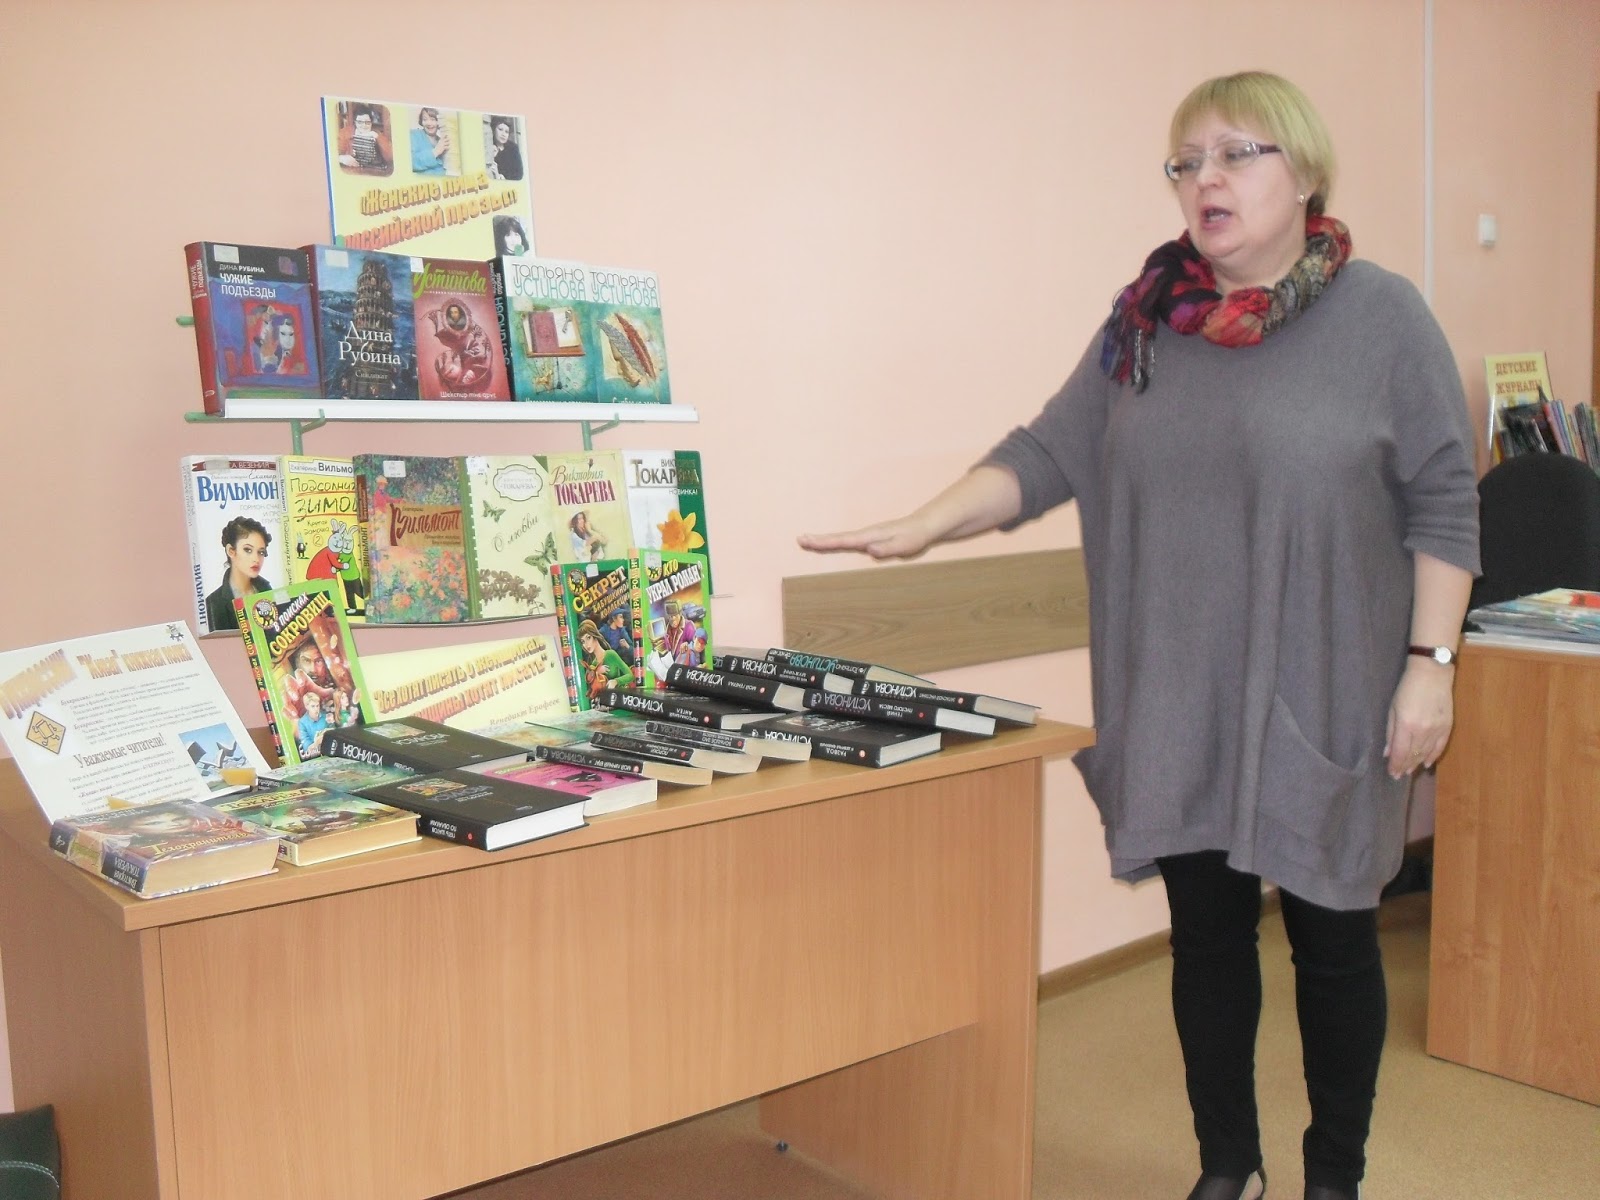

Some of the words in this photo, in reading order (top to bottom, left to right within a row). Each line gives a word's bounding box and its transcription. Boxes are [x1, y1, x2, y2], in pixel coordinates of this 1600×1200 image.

[219, 263, 238, 271] ДИНА
[239, 265, 265, 273] РУБИНА
[219, 272, 254, 285] ЧУЖИЕ
[413, 263, 487, 298] Устинова
[514, 276, 586, 299] УСТИНОВА
[221, 284, 276, 299] ПОДЪЕЗДЫ
[592, 283, 660, 308] УСТИНОВА
[344, 320, 393, 343] Дина
[338, 341, 401, 366] Рубина
[238, 461, 270, 469] ВЕЗЕНИЯ
[318, 462, 353, 473] Вильмо
[550, 465, 604, 485] Виктория
[197, 476, 279, 509] Вильмон
[554, 480, 616, 506] ТОКАРЕВА
[360, 527, 370, 568] ВИЛЬМОНТ
[663, 559, 679, 578] КТО
[573, 566, 627, 612] СЕКРЕТ
[646, 578, 673, 604] УКРАЛ
[671, 561, 704, 592] РОМАН?
[194, 563, 208, 626] ВИЛЬМОНТ
[600, 592, 630, 619] КОЛЛЕКЦИ
[237, 607, 256, 655] СОКРОВИЩ
[269, 591, 334, 656] СОКРОВИЩ
[633, 619, 641, 633] КТО
[742, 659, 777, 675] УСТИНОВА
[789, 653, 836, 674] УСТИНОВА
[686, 668, 724, 686] УСТИНОВА
[875, 682, 917, 698] УСТИНОВА
[622, 694, 664, 713] УСТИНОВА
[823, 692, 871, 711] УСТИНОВА
[886, 710, 903, 718] ГЕНИЙ
[73, 745, 128, 769] Уважаемые
[127, 732, 167, 753] читатели!
[343, 743, 383, 766] УСТИНОВА
[551, 749, 586, 764] УСТИНОВА
[826, 747, 847, 757] РАЗВОД
[141, 832, 250, 856] Телохранитель
[114, 857, 140, 878] ТОКАРЕВА
